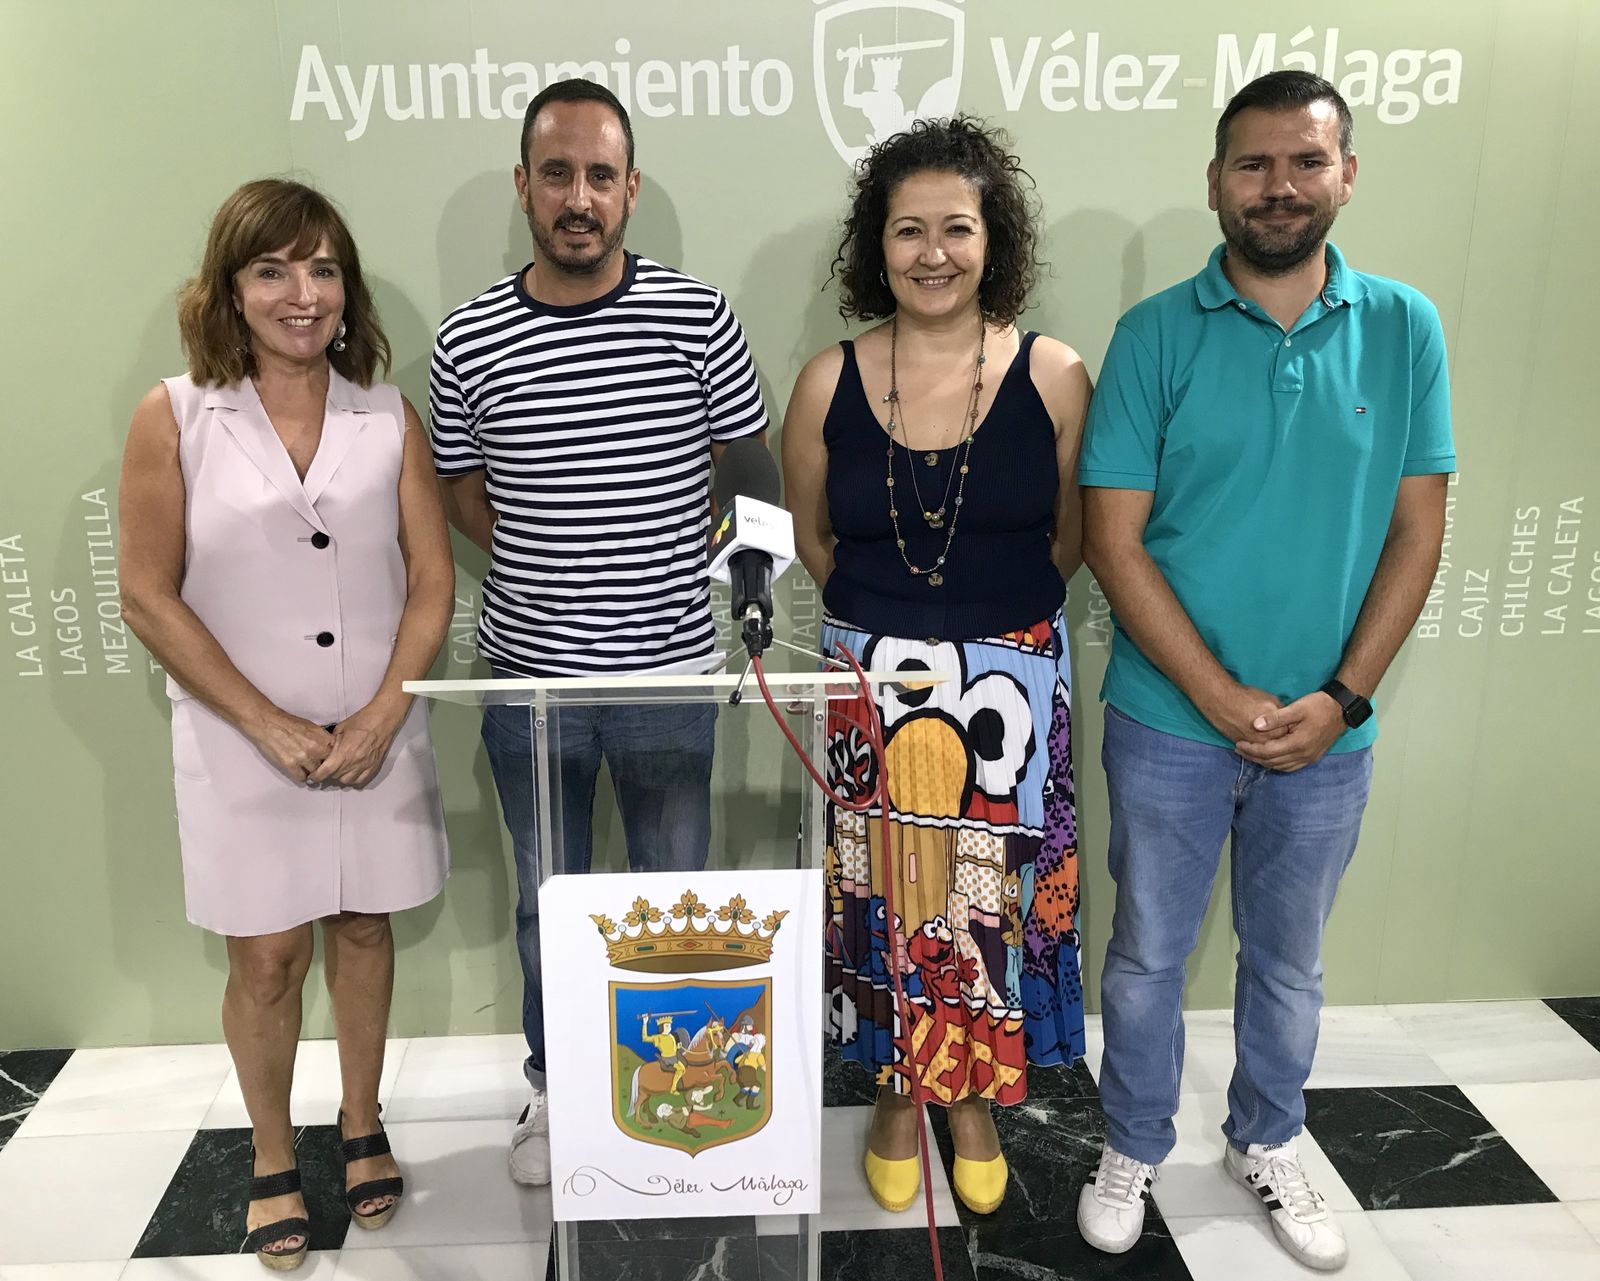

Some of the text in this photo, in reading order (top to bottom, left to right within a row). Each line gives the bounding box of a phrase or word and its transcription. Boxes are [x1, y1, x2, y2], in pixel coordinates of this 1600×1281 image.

[0, 534, 43, 676] LA CALETA
[1458, 568, 1490, 637] CAJIZ
[1500, 505, 1541, 637] CHILCHES
[1541, 496, 1585, 634] LA CALETA
[50, 587, 88, 676] LAGOS
[451, 594, 479, 664] CAJIZ
